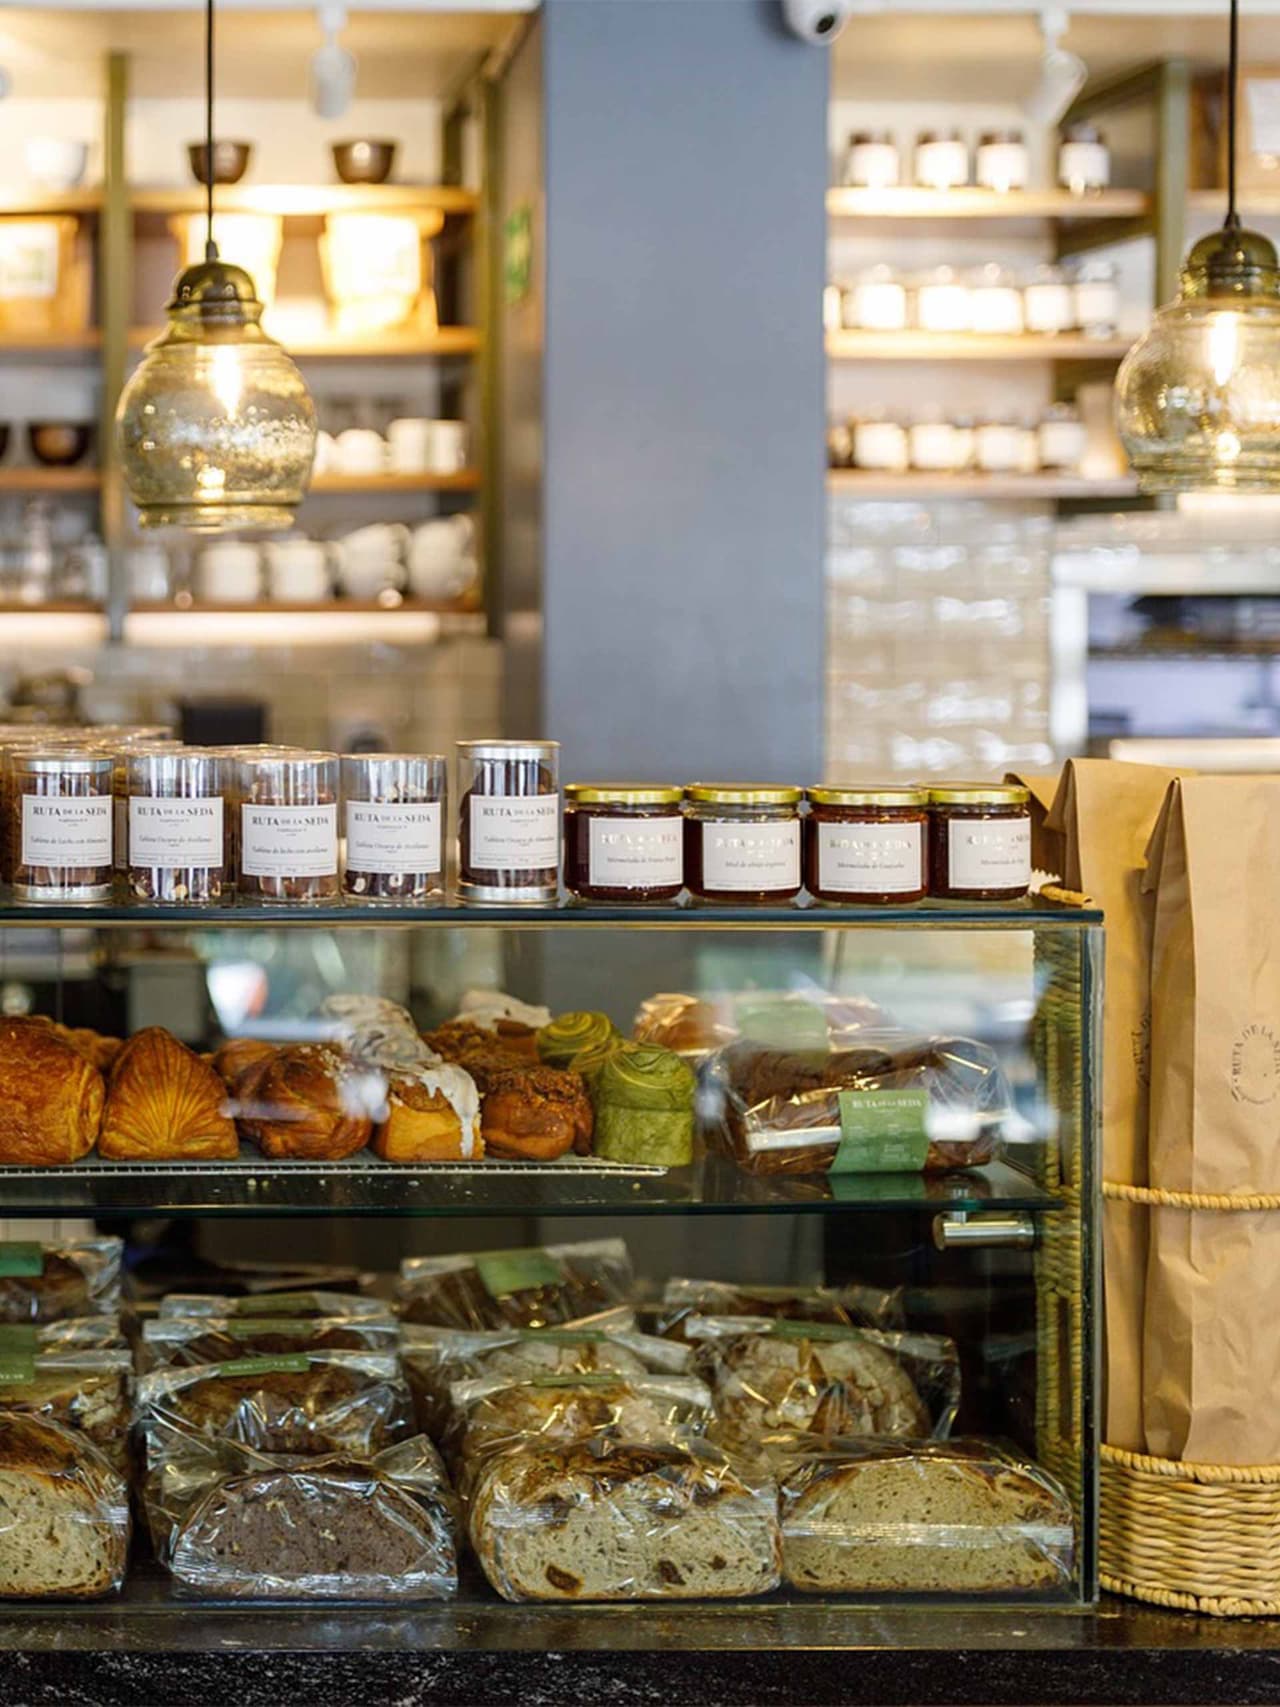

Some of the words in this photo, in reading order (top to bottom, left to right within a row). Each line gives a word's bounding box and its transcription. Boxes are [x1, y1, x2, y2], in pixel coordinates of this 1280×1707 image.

[32, 806, 60, 816] RUTA
[86, 806, 107, 816] SEDA
[137, 807, 162, 816] RUTA
[187, 807, 214, 816] SEDA
[482, 807, 512, 817] RUTA
[252, 816, 279, 826] RUTA
[305, 816, 329, 826] SEDA
[354, 812, 379, 822] RUTA
[405, 812, 431, 822] SEDA
